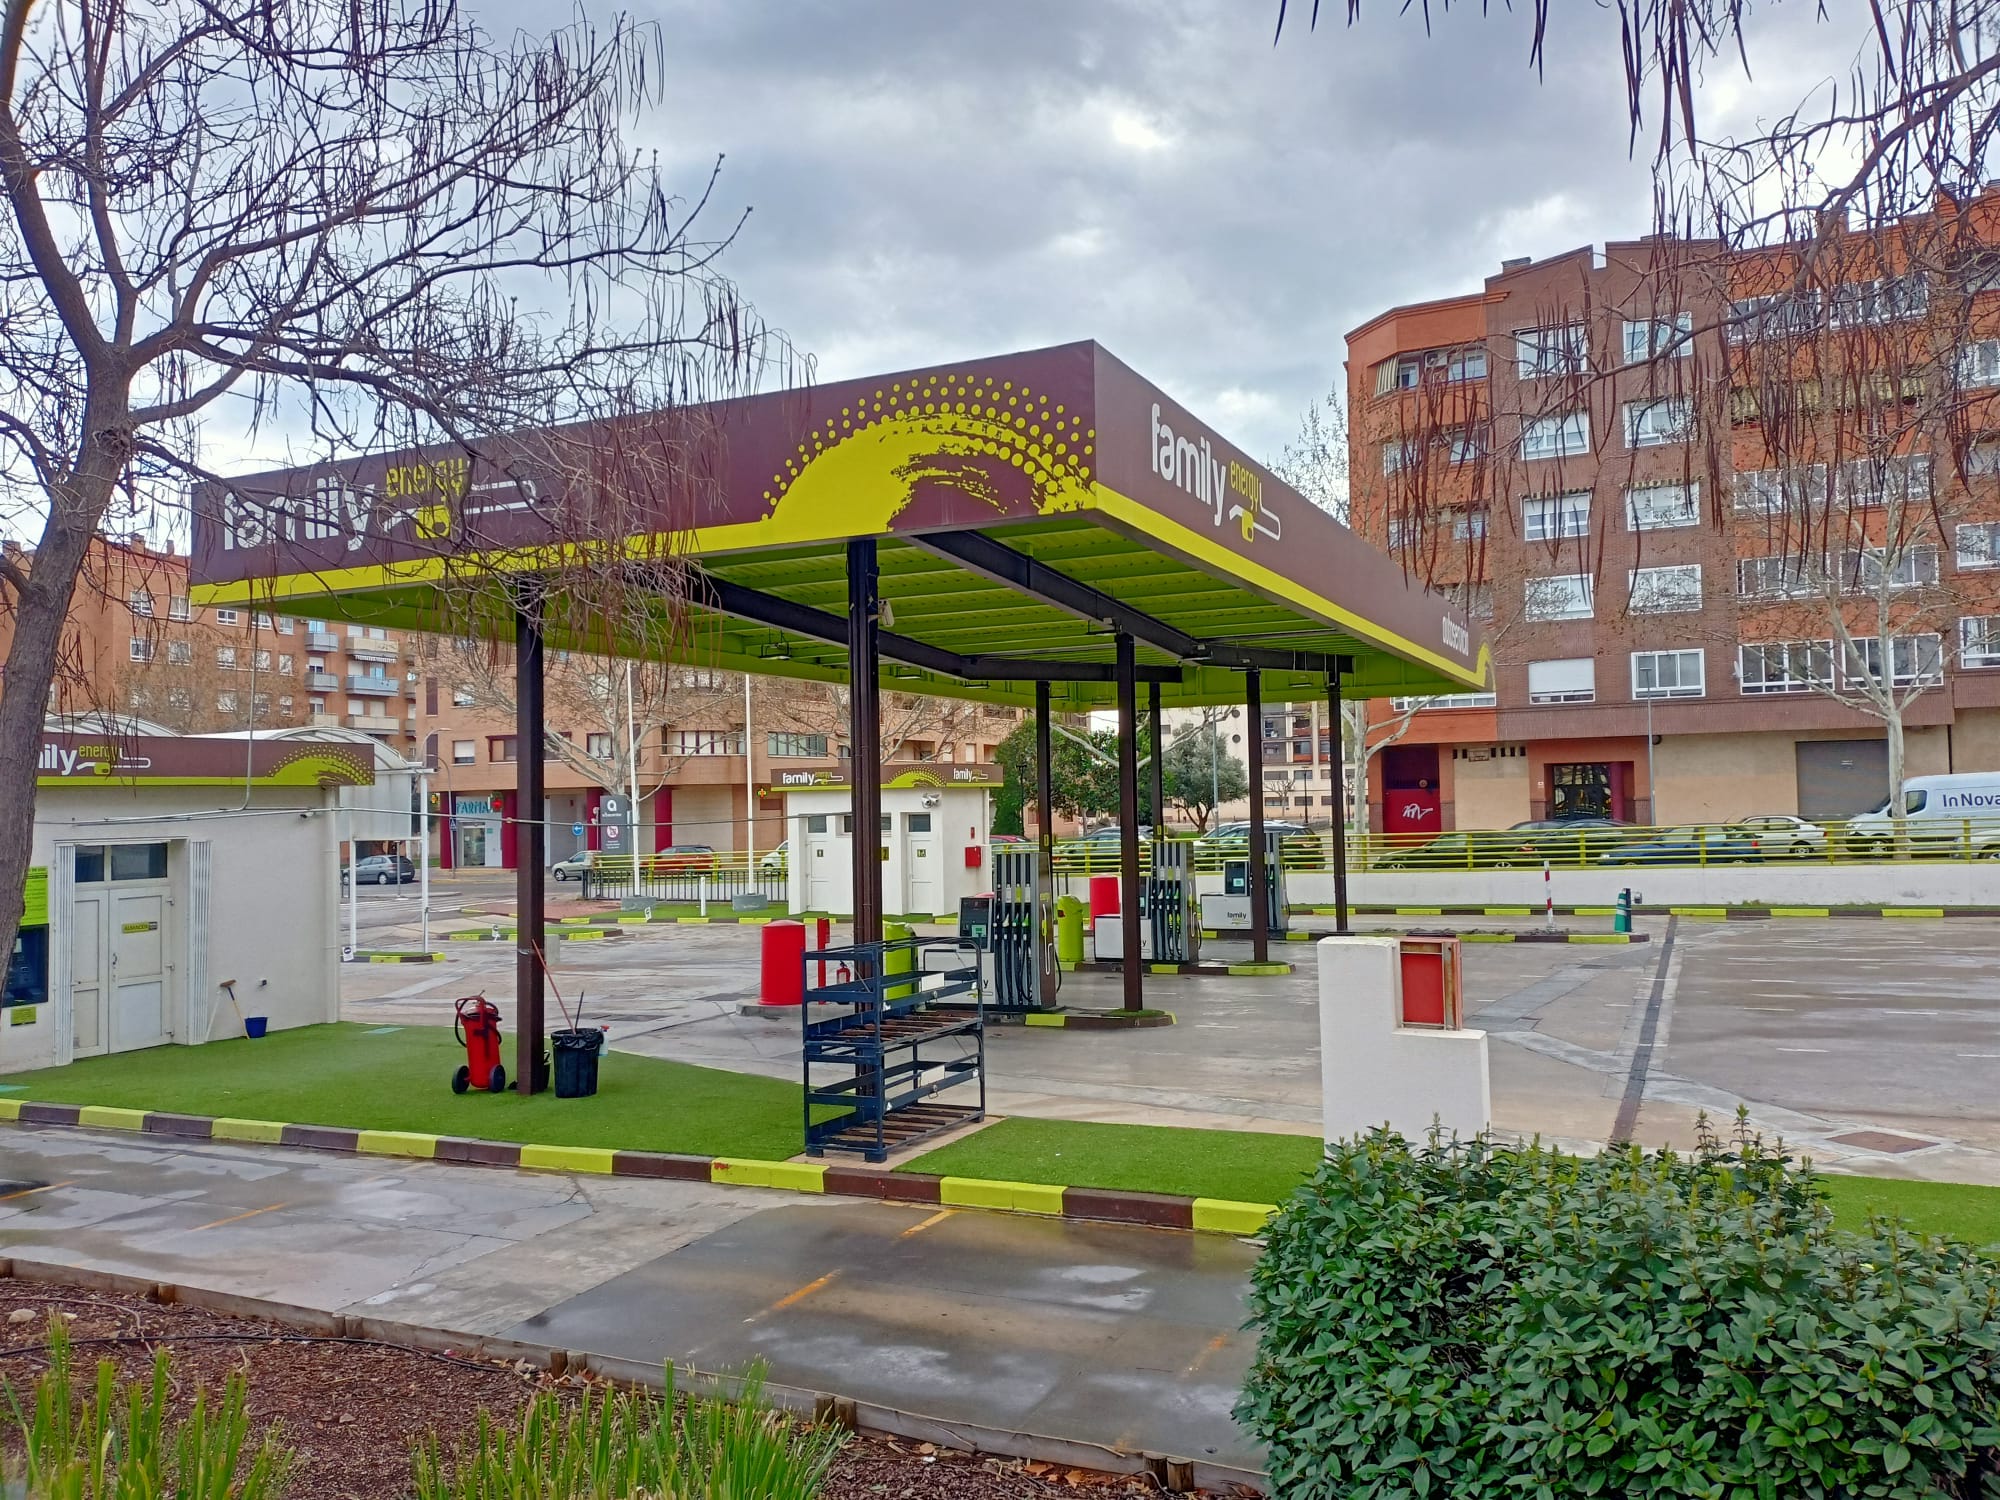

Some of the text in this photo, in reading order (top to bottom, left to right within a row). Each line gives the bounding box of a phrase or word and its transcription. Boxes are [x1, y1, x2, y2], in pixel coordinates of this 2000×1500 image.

[386, 458, 463, 505] energy
[1151, 402, 1226, 526] family
[1230, 460, 1259, 512] energy
[224, 476, 375, 551] family
[38, 743, 77, 776] ily
[782, 771, 815, 785] family
[953, 767, 972, 782] family
